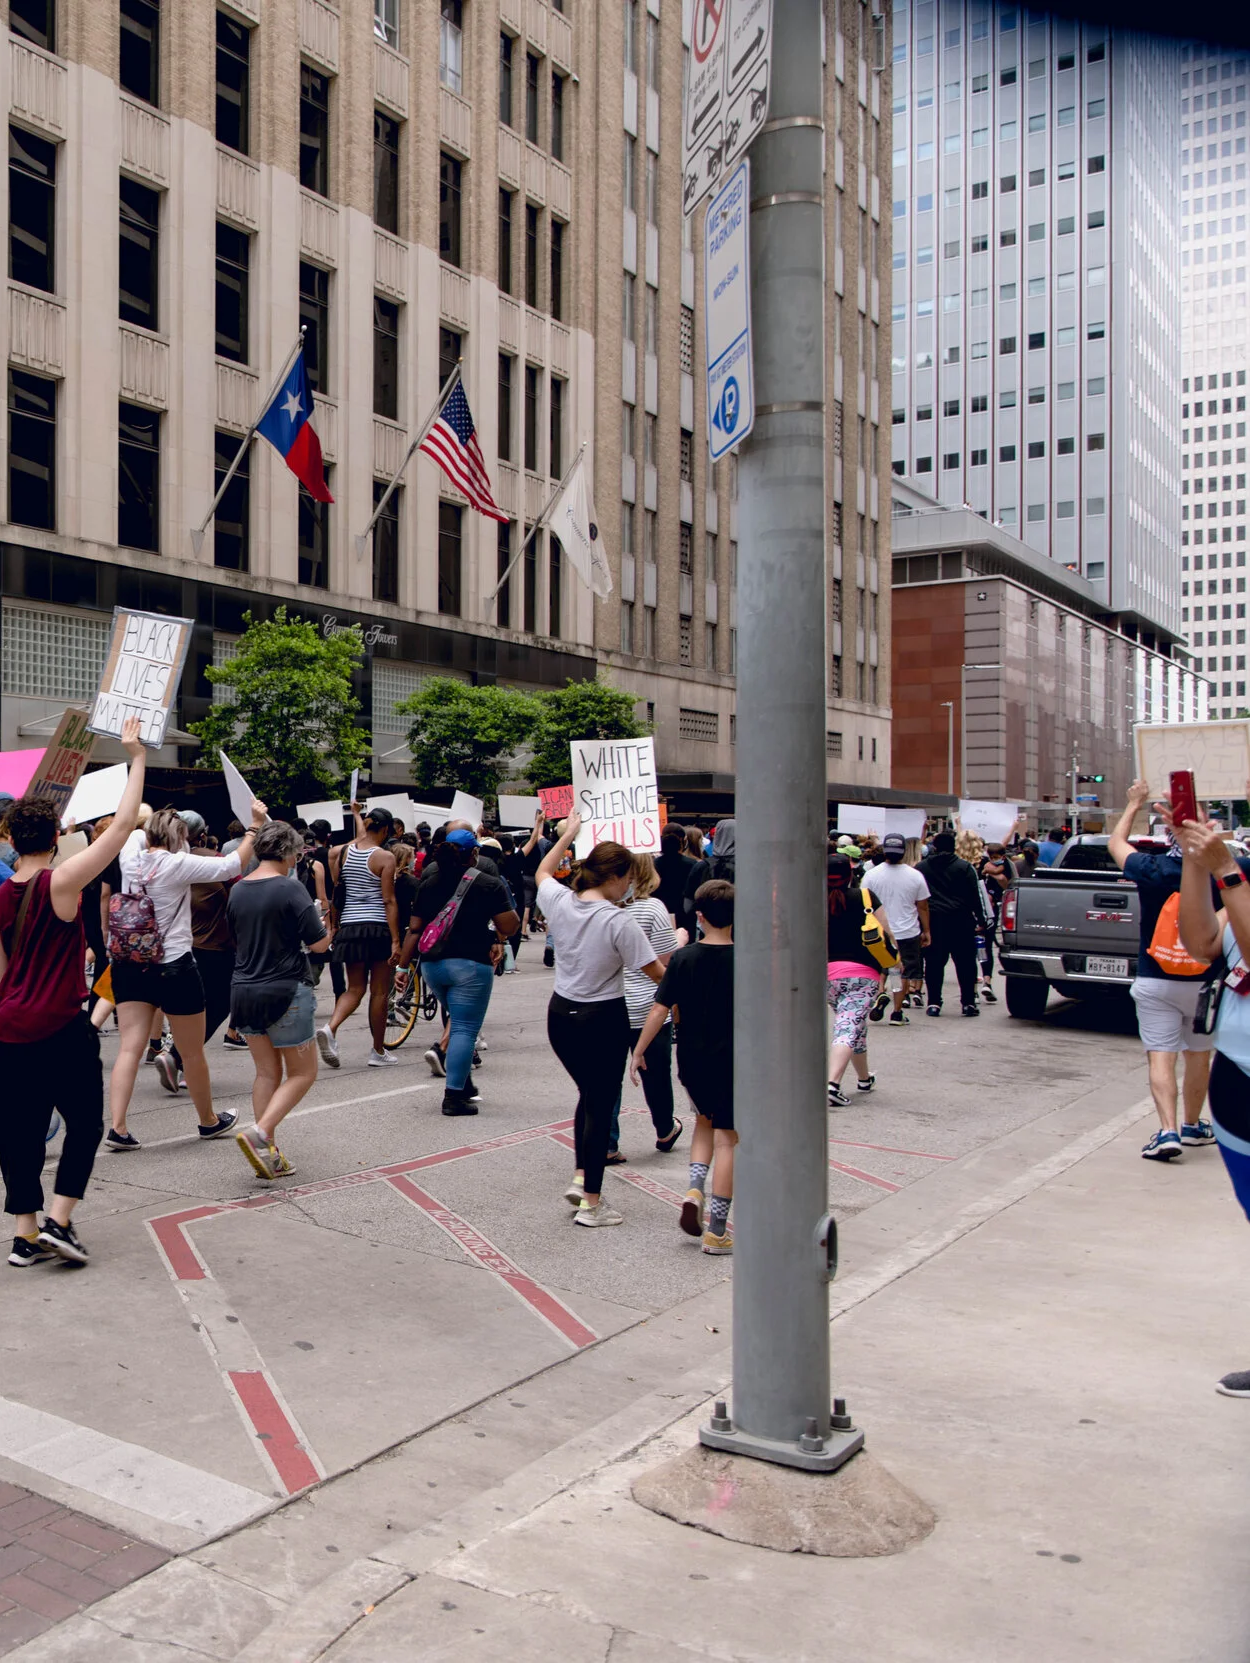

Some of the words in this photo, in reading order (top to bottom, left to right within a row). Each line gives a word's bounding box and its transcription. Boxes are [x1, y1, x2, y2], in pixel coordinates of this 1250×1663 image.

[709, 180, 743, 235] METERED
[710, 214, 742, 259] PARKING
[123, 616, 177, 662] BLACK
[365, 625, 398, 646] Towers
[113, 657, 169, 702] LIVES
[45, 748, 84, 785] LIVES
[579, 745, 650, 780] WHITE
[580, 784, 658, 823] SILENCE
[592, 817, 656, 848] KILLS
[1086, 910, 1133, 923] GMC
[440, 1219, 497, 1256] PARKING
